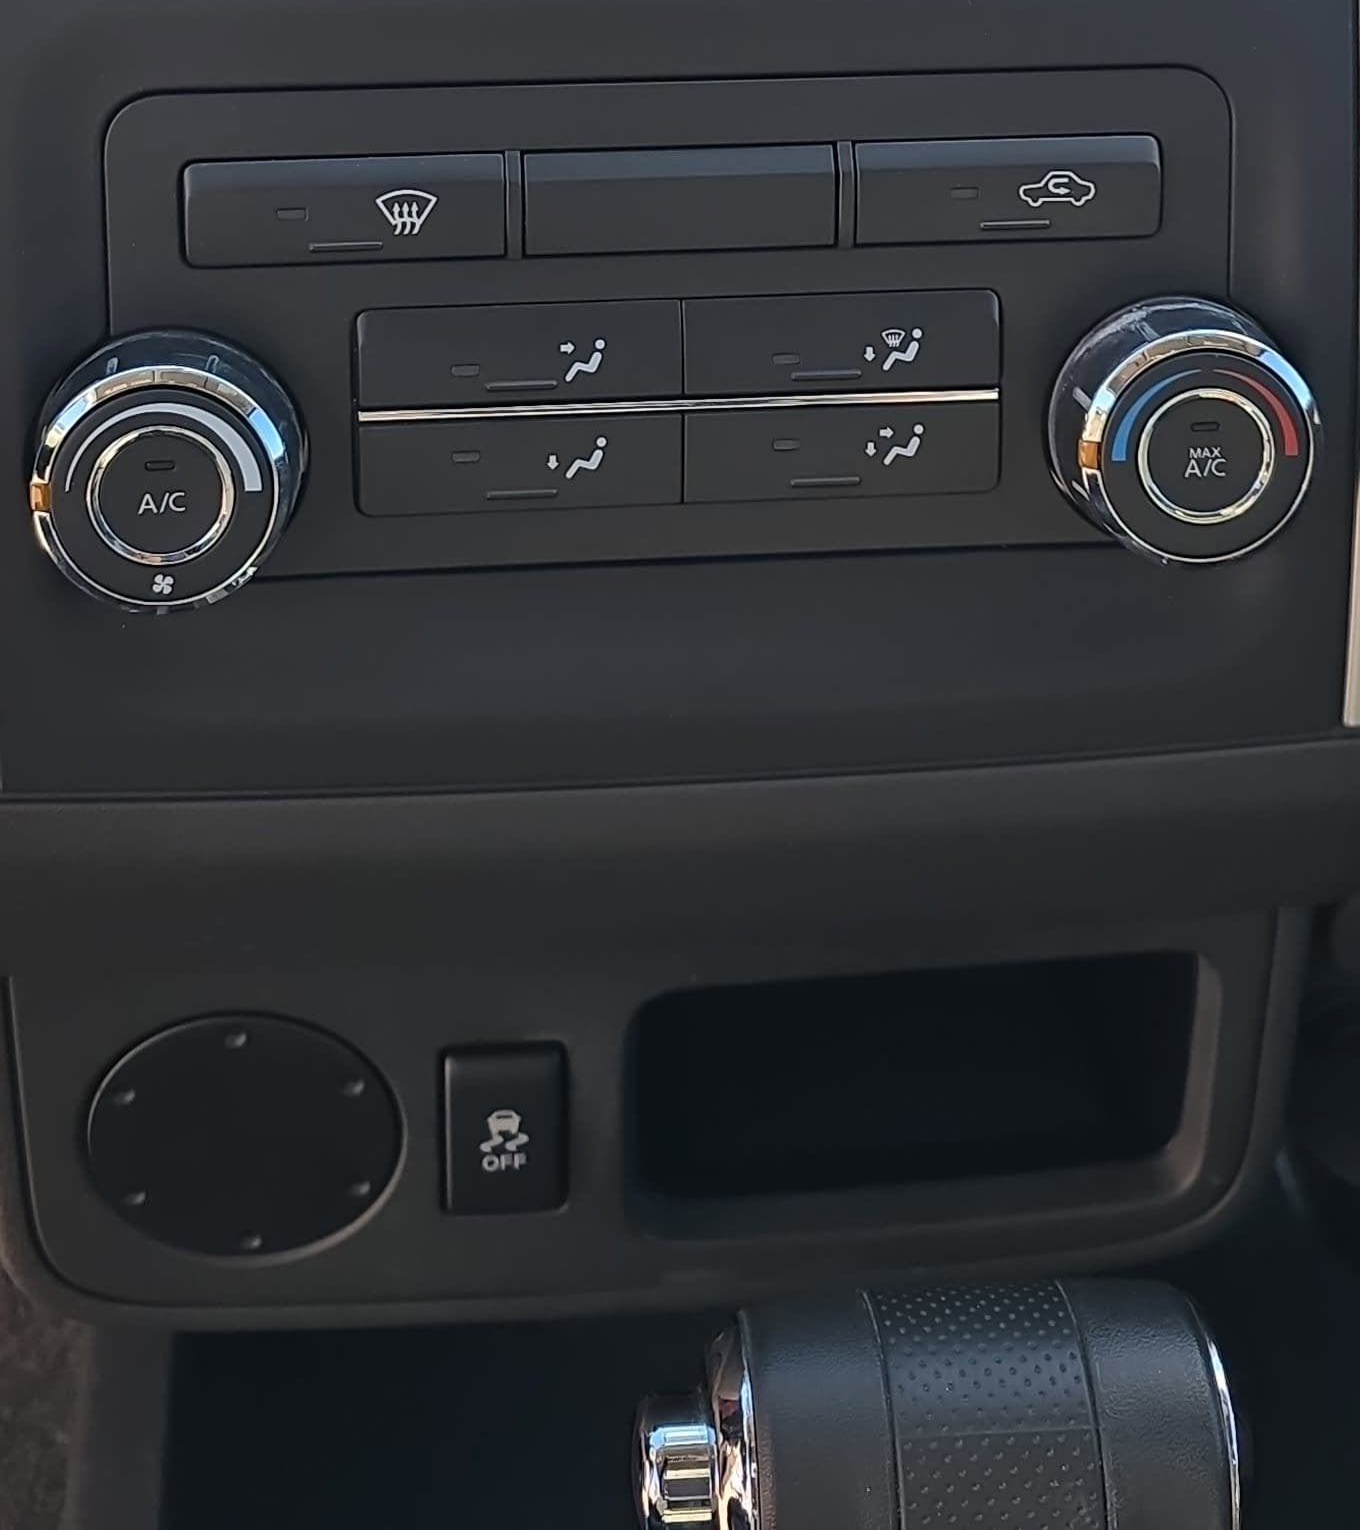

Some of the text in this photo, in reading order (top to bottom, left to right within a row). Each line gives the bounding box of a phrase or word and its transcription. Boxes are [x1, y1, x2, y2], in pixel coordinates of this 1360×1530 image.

[1190, 448, 1223, 459] MAX
[1184, 458, 1228, 478] A/C
[139, 493, 185, 514] A/C
[482, 1153, 527, 1171] OFF
